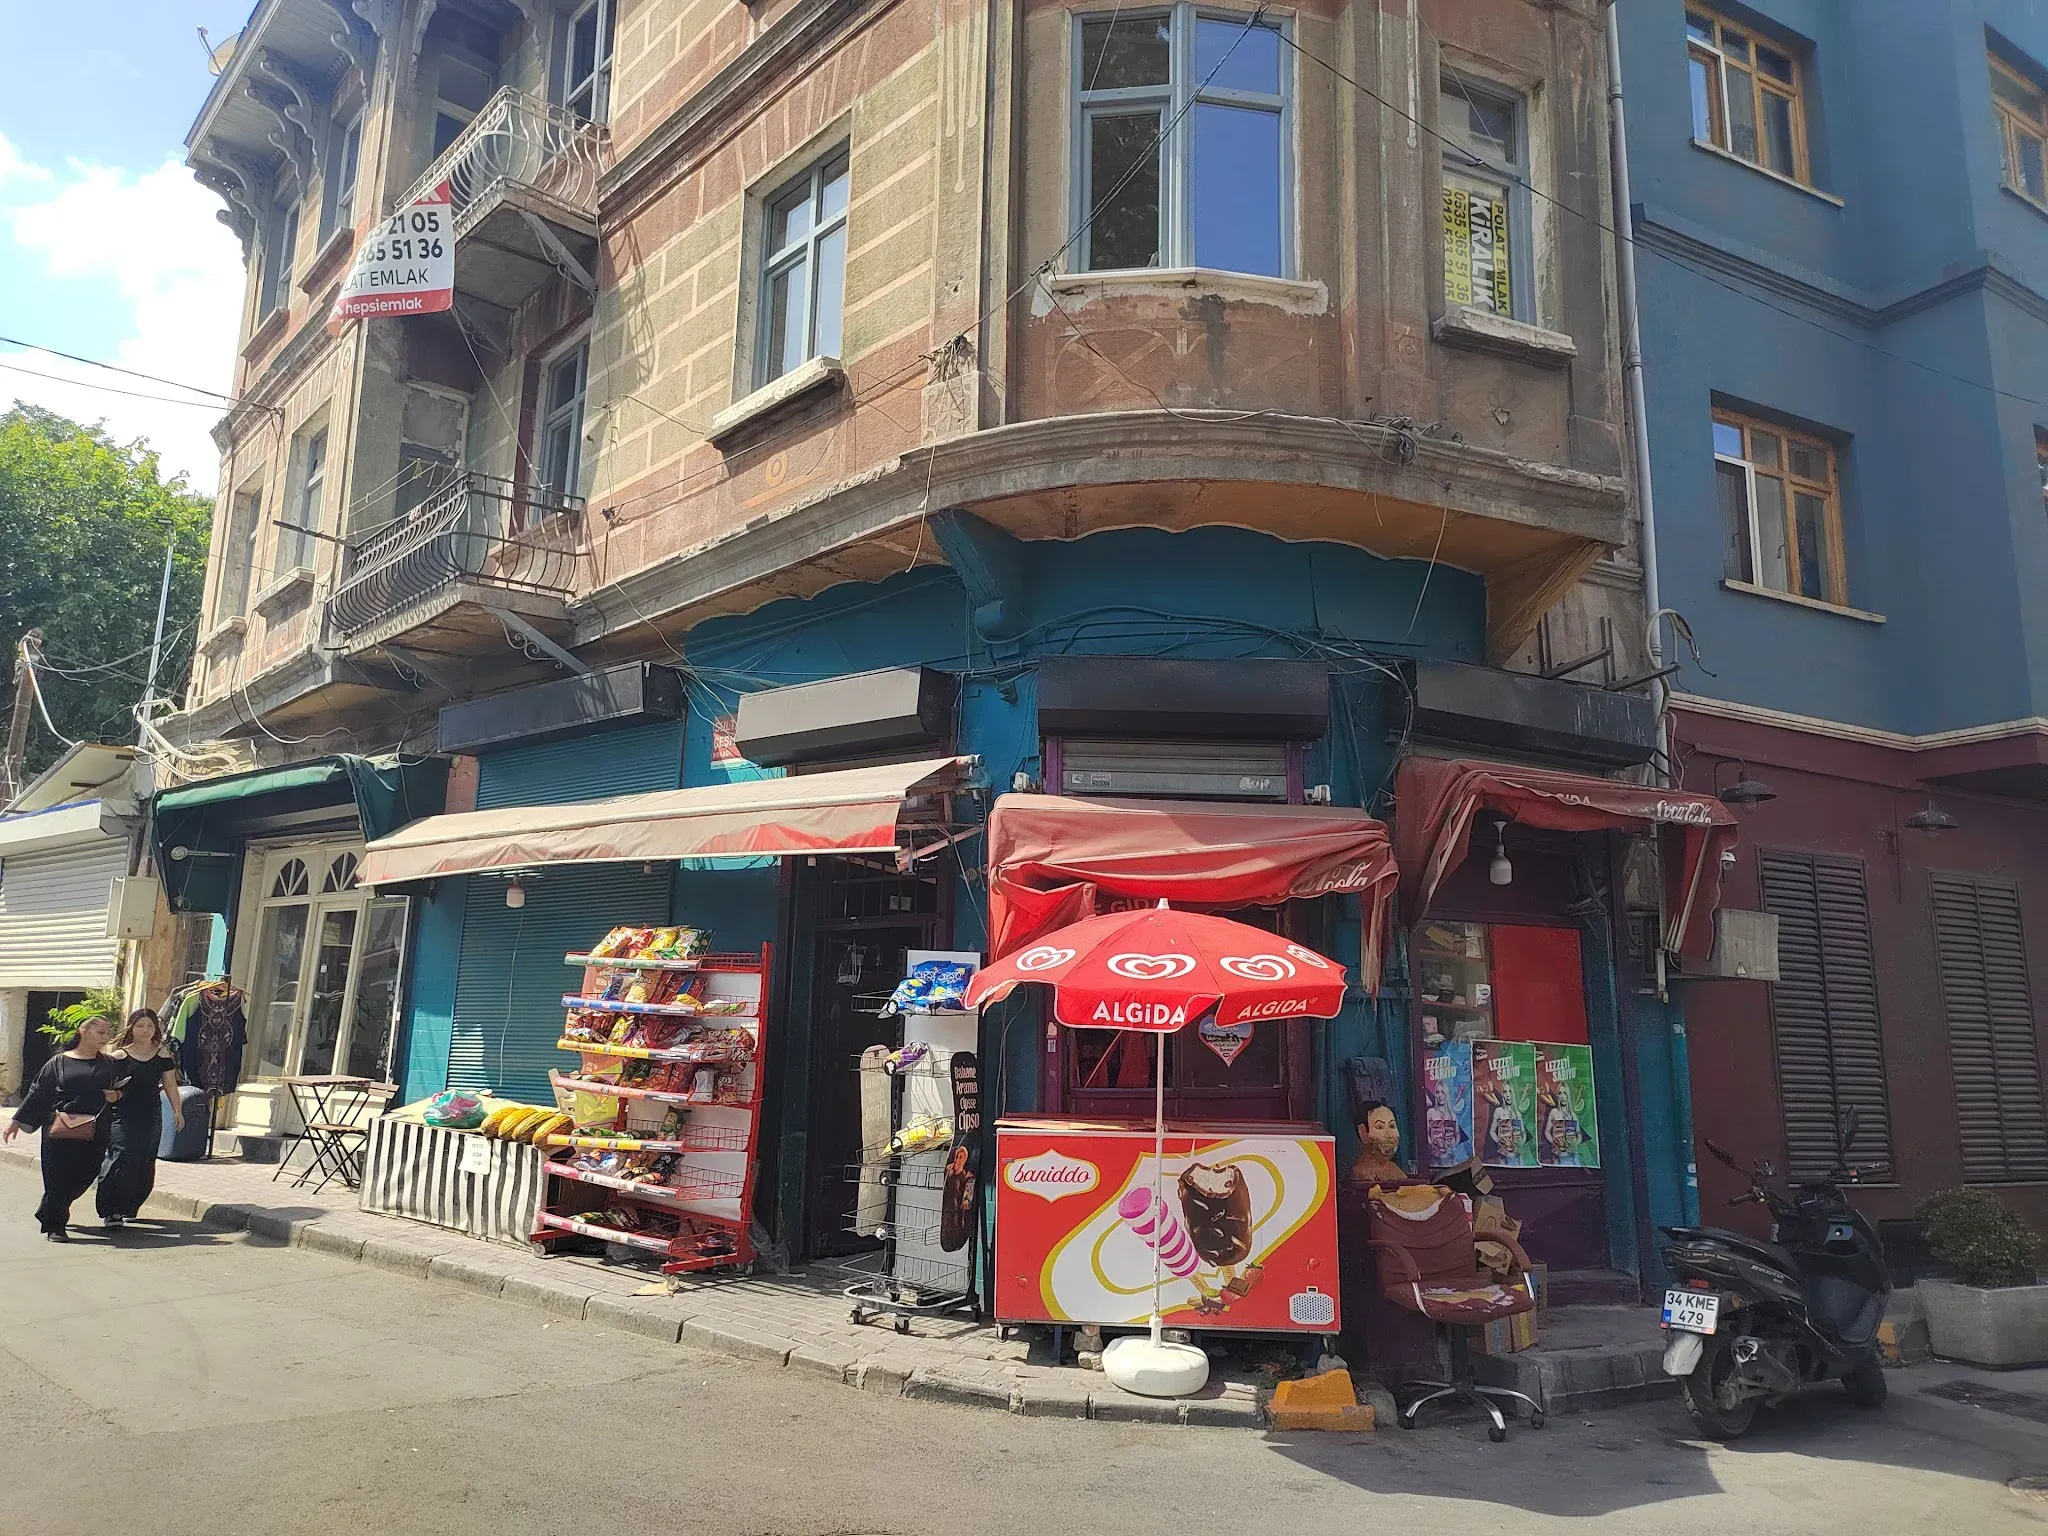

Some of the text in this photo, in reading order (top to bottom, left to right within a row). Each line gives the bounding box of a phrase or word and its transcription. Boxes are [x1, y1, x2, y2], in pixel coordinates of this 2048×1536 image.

[412, 212, 440, 233] 05
[391, 239, 412, 260] 51
[418, 238, 443, 259] 36
[1453, 191, 1469, 302] 0535 365 51 36
[1493, 204, 1508, 311] POLAT EMLAK
[370, 267, 429, 286] EMLAK
[345, 297, 422, 315] hepsiemlak
[956, 1081, 978, 1095] Arama
[1014, 1164, 1091, 1183] baniddo
[1667, 1292, 1716, 1311] 34 KME
[1678, 1309, 1704, 1324] 479
